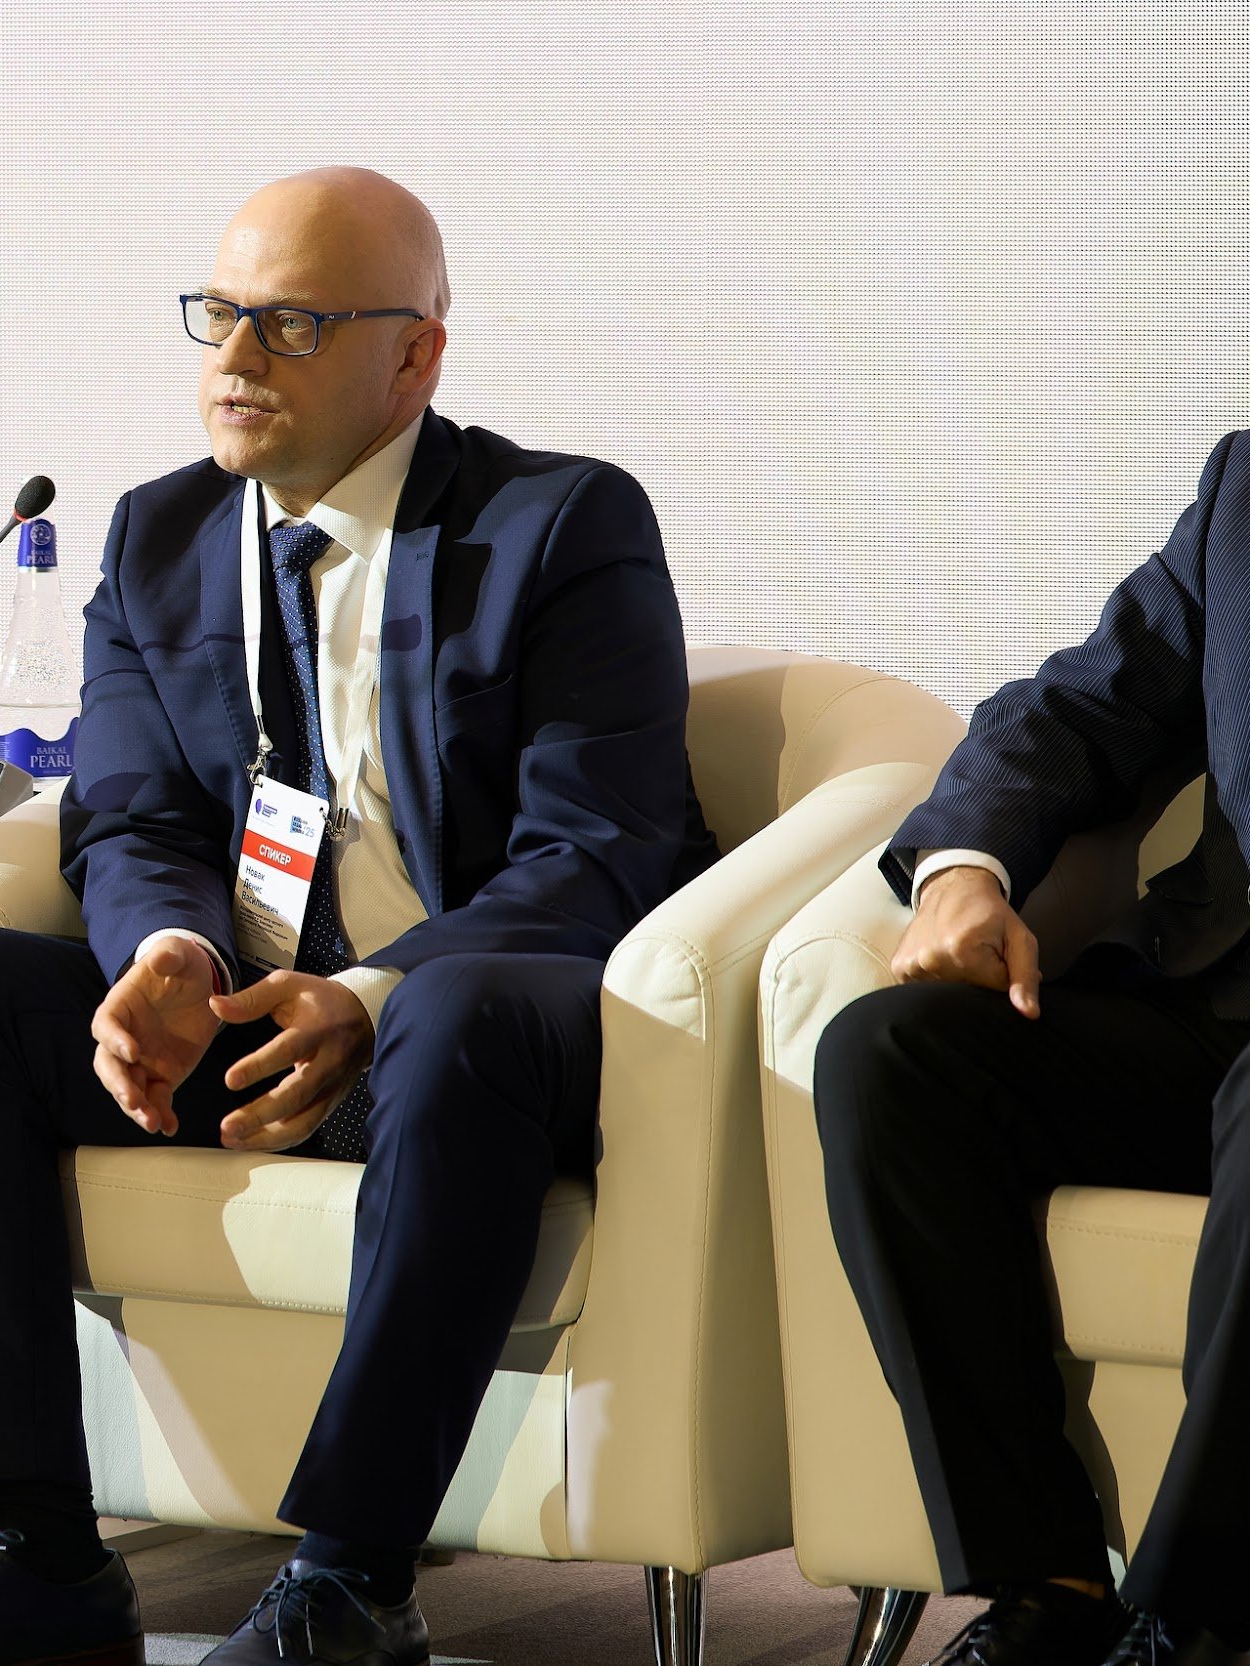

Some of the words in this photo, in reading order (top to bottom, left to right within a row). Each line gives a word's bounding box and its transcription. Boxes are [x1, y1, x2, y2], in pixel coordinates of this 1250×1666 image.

[26, 555, 55, 565] PEARL
[36, 746, 67, 755] BAIKAL
[30, 755, 73, 769] PEARL
[259, 844, 292, 866] СПИКЕР
[245, 864, 265, 882] Новак
[242, 877, 263, 895] Денис
[241, 890, 279, 916] Васильевич
